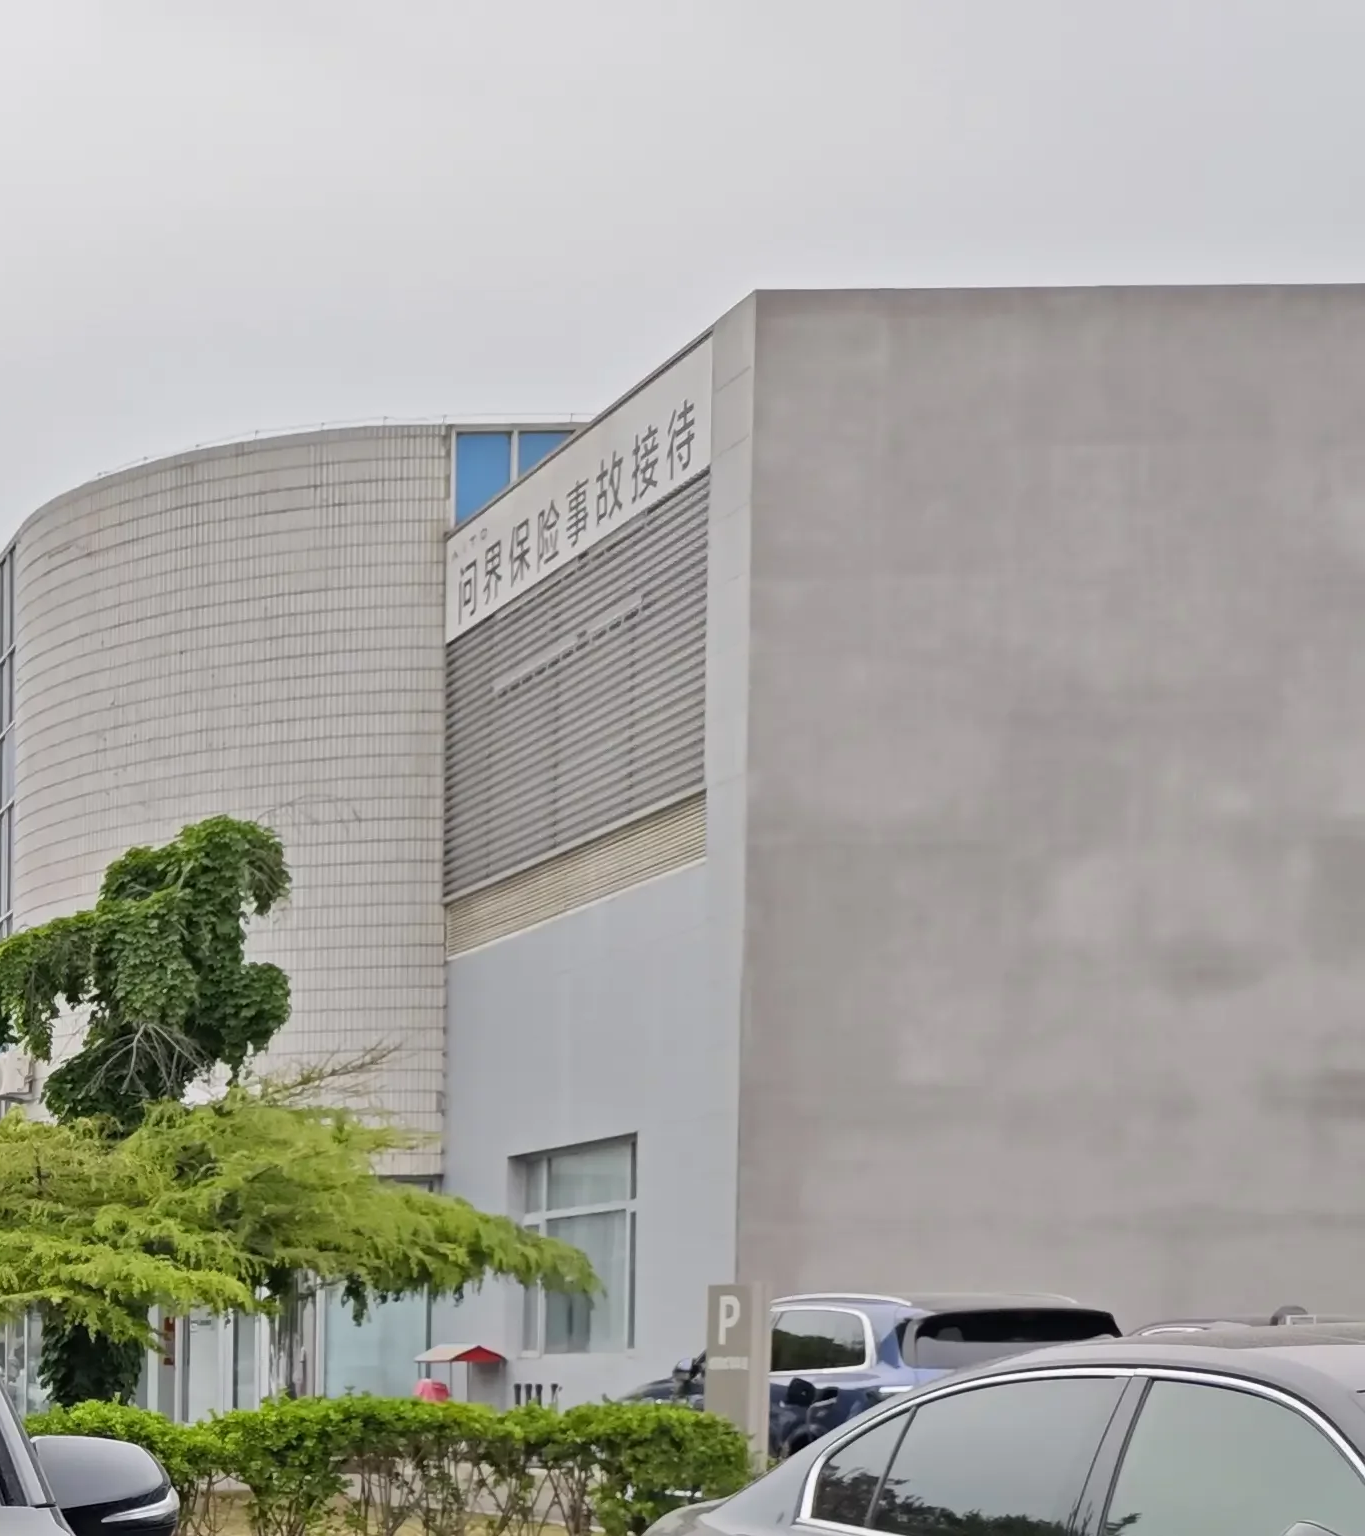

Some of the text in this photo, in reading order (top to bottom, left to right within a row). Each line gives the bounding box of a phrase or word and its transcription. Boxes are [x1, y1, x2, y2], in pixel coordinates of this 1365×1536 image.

[458, 399, 696, 625] 问界保险事故接待
[718, 1295, 740, 1345] P
